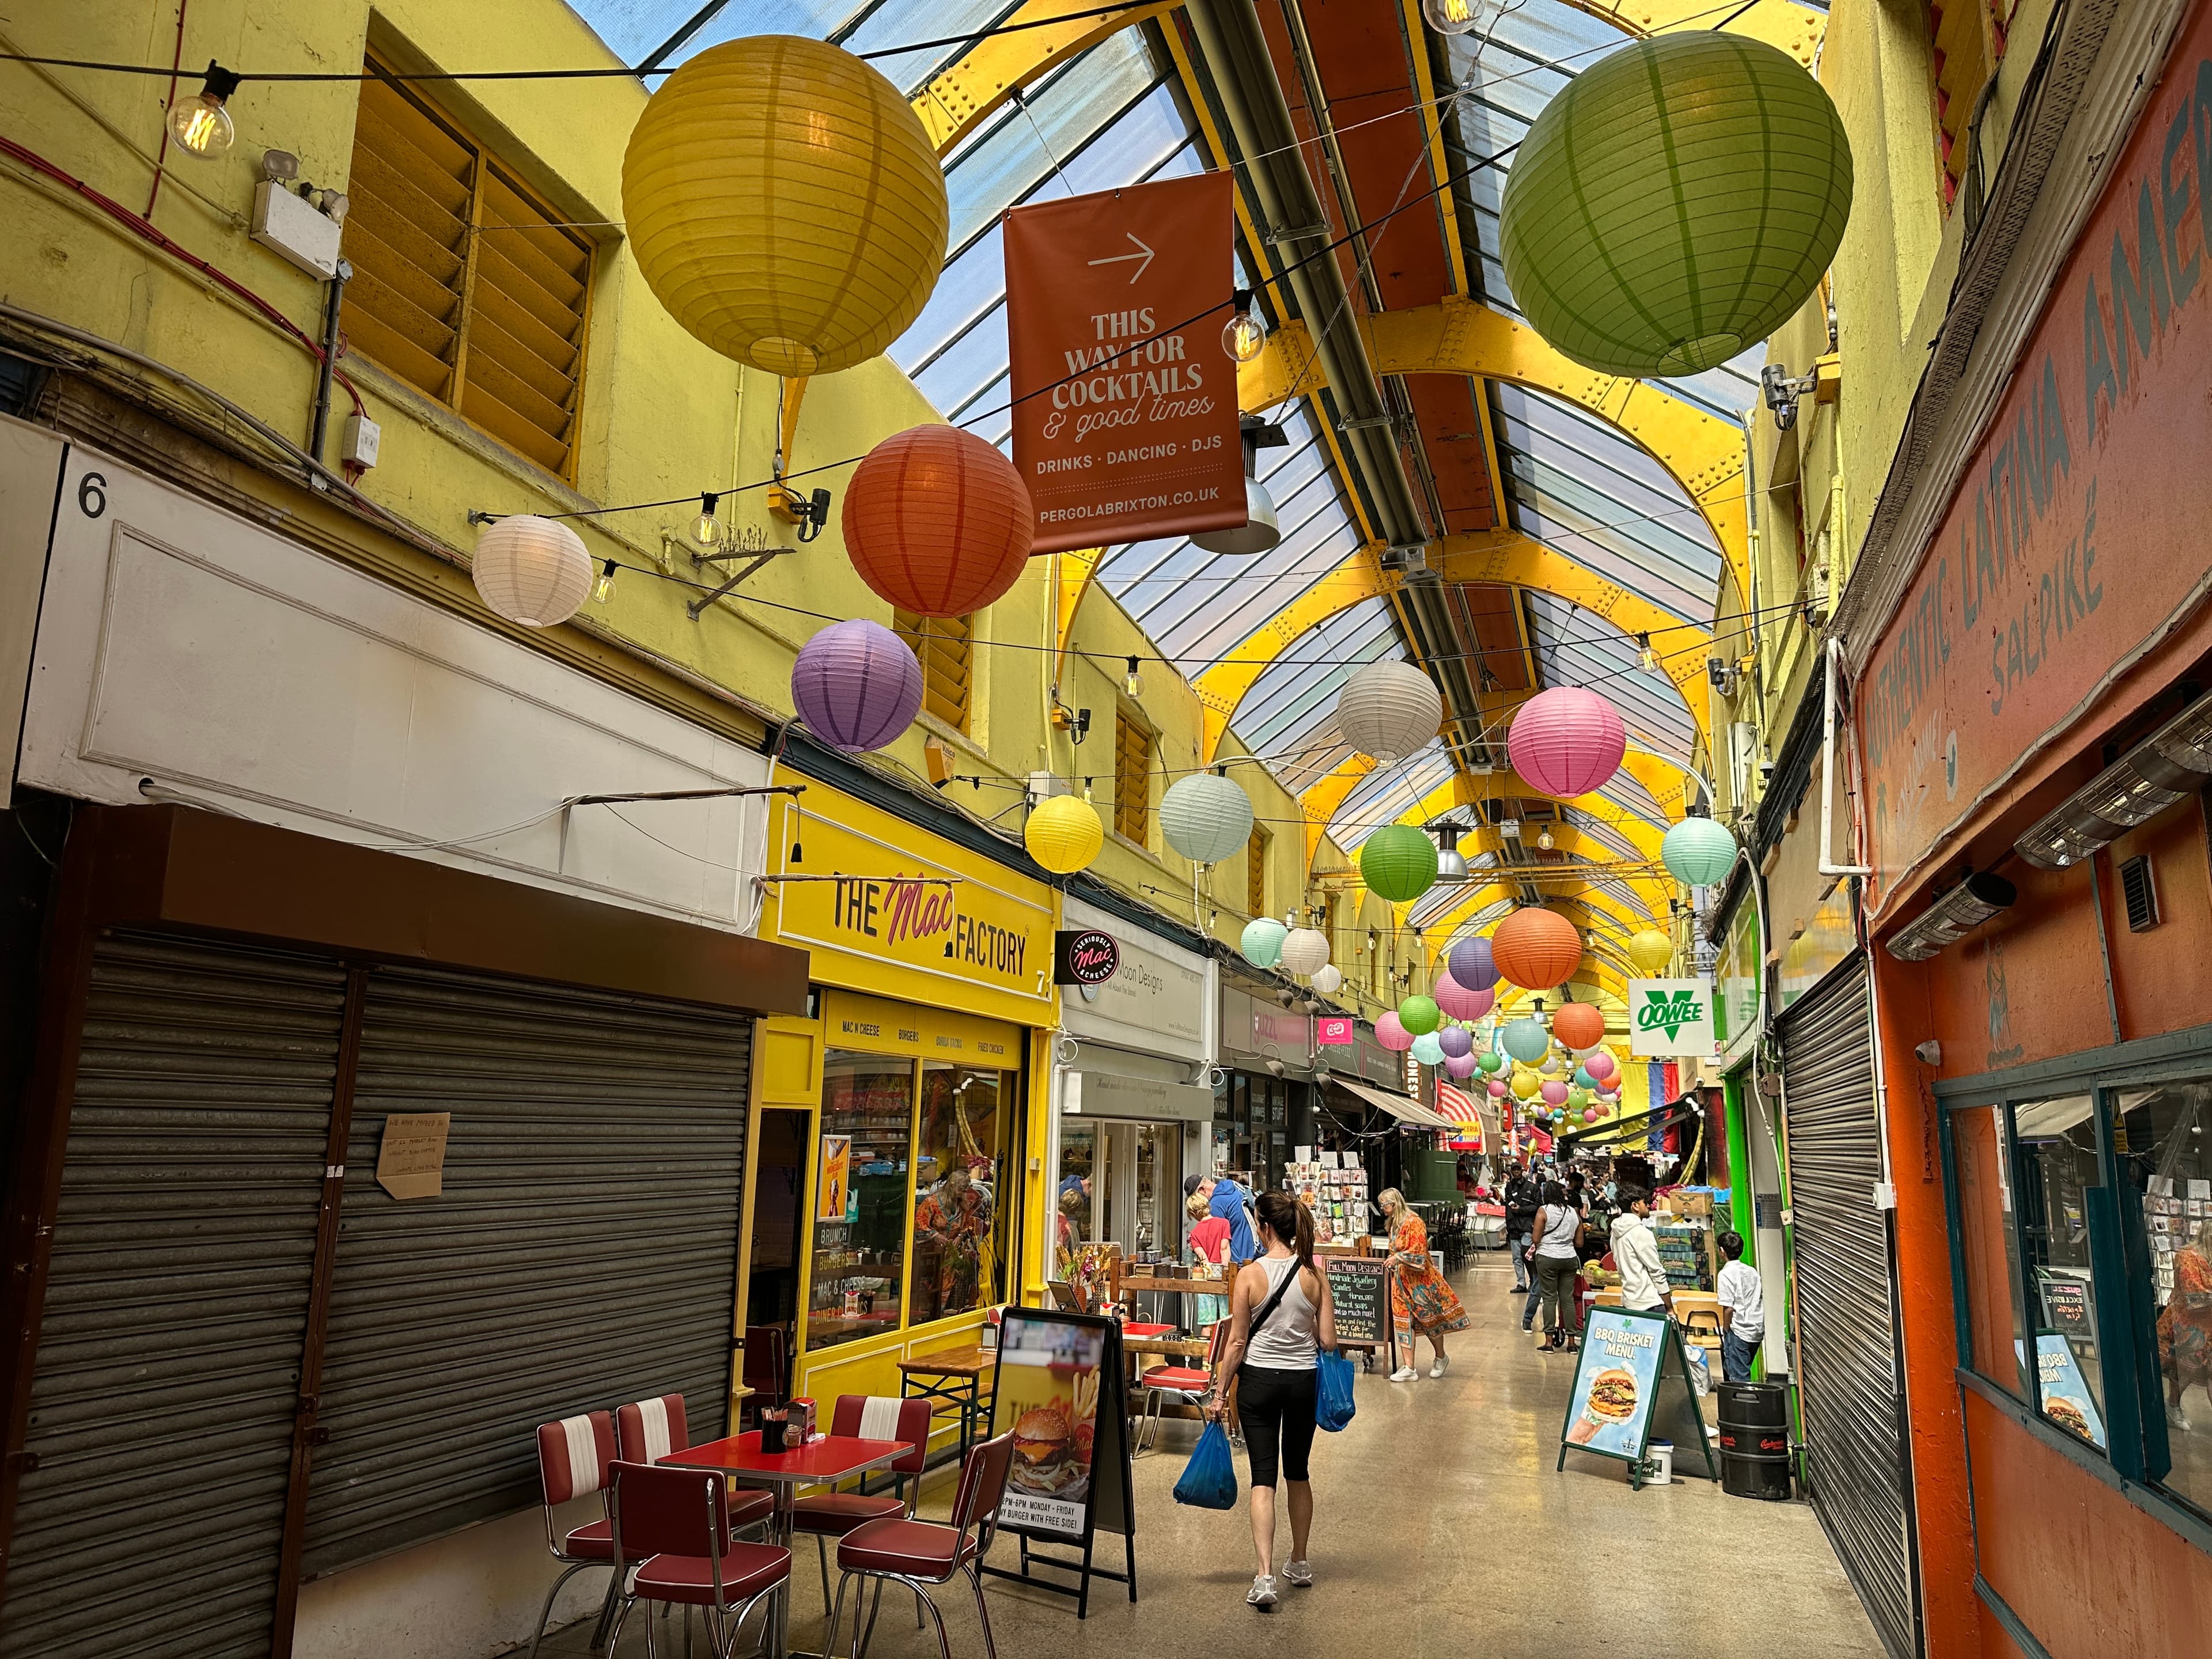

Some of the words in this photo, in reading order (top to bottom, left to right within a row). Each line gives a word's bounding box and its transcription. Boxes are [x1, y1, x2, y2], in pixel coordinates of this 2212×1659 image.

[1091, 307, 1155, 342] THIS
[1065, 342, 1126, 376] WAY
[1130, 335, 1185, 367] FOR
[1052, 363, 1203, 410] COCKTAILS
[1043, 411, 1067, 440] &
[1075, 395, 1145, 444] good
[1149, 392, 1215, 423] times
[1036, 455, 1093, 475] DRINKS
[1107, 442, 1177, 465] DANCING
[1191, 434, 1222, 452] DJS
[78, 472, 107, 519] 6
[1039, 486, 1220, 524] PERGOLABRIXTON.CO.UK
[1866, 557, 1950, 789] AUTHENTIC
[1961, 350, 2071, 632] LATINA
[834, 871, 880, 937] THE
[883, 871, 954, 946] Mac
[955, 913, 1027, 978] FACTORY
[1077, 935, 1111, 950] SERIOUSLY
[1074, 948, 1112, 970] Mac
[1037, 969, 1046, 994] 7
[1117, 959, 1137, 982] Moon
[1139, 964, 1162, 995] Designs
[1637, 1002, 1703, 1027] OOWEE
[842, 1020, 853, 1033] MAC
[854, 1022, 858, 1034] N
[859, 1023, 880, 1037] CHEESE
[898, 1029, 919, 1043] BURGERS
[978, 1041, 988, 1052] FRIED
[988, 1043, 1004, 1055] CHICKEN
[1219, 1101, 1228, 1113] BAR
[1272, 1107, 1284, 1120] STUFF
[820, 1226, 847, 1244] BRUNCH
[819, 1252, 850, 1271] BURGERS
[1328, 1262, 1342, 1271] FULL
[1342, 1262, 1357, 1272] MOON
[1358, 1262, 1381, 1274] DESIGNS
[817, 1281, 832, 1298] MAC
[834, 1280, 838, 1296] &
[840, 1276, 865, 1294] CHEESE
[1327, 1272, 1351, 1282] Handmade
[1351, 1274, 1377, 1290] Jewellery
[815, 1306, 835, 1325] DINER
[1354, 1302, 1368, 1310] soaps
[1368, 1320, 1377, 1328] the
[1594, 1327, 1616, 1343] BBQ
[1617, 1330, 1655, 1349] BRISKET
[1605, 1344, 1637, 1360] MENU.
[1029, 1501, 1051, 1512] MONDAY
[1056, 1505, 1075, 1516] FRIDAY
[1007, 1510, 1029, 1521] BURGER
[1030, 1513, 1044, 1524] WITH
[1045, 1515, 1060, 1527] FREE
[1061, 1518, 1077, 1529] SIDE!
